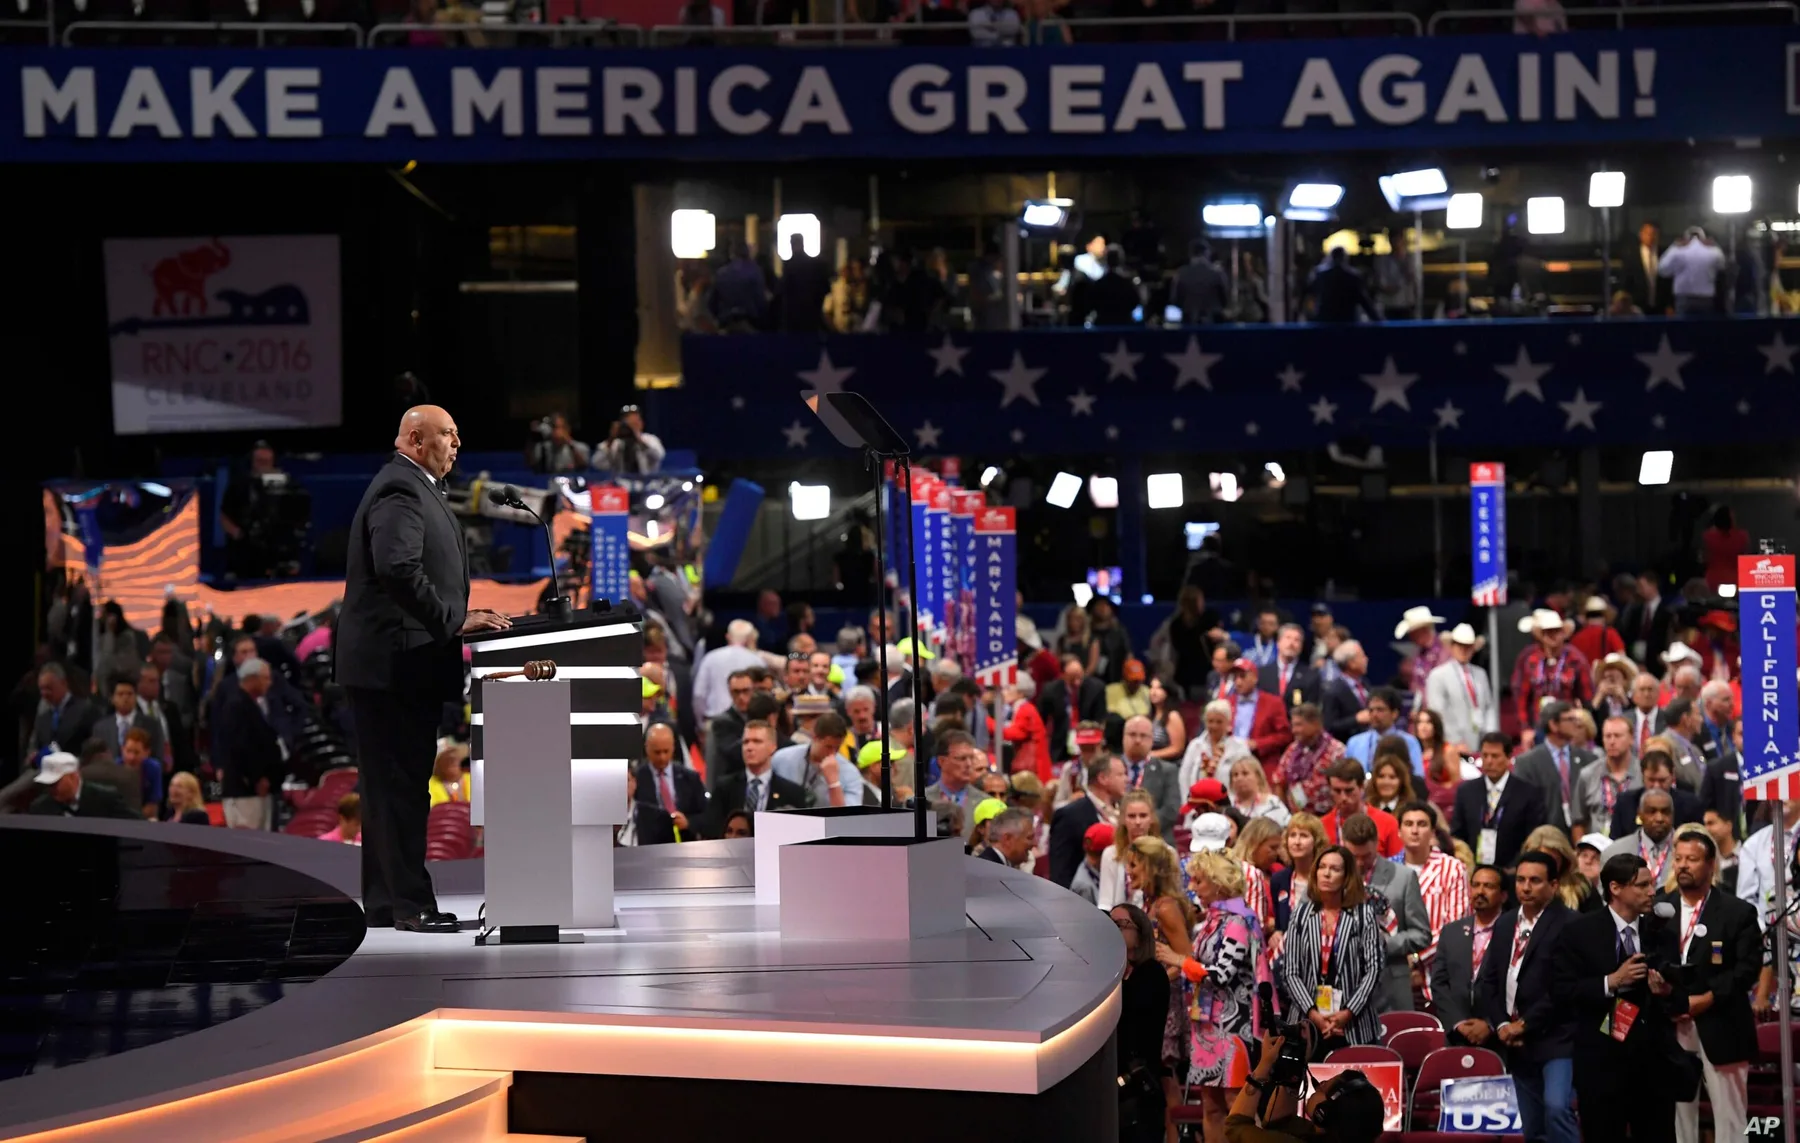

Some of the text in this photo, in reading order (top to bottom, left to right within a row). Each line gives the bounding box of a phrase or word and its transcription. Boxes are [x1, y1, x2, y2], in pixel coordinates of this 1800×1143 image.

[21, 49, 1658, 138] MAKE AMERICA GREAT AGAIN!
[141, 338, 313, 375] RNC 2016
[144, 378, 314, 406] CLEVELAND
[987, 536, 1004, 653] MARYLAND
[1760, 594, 1780, 755] CALIFORNIA
